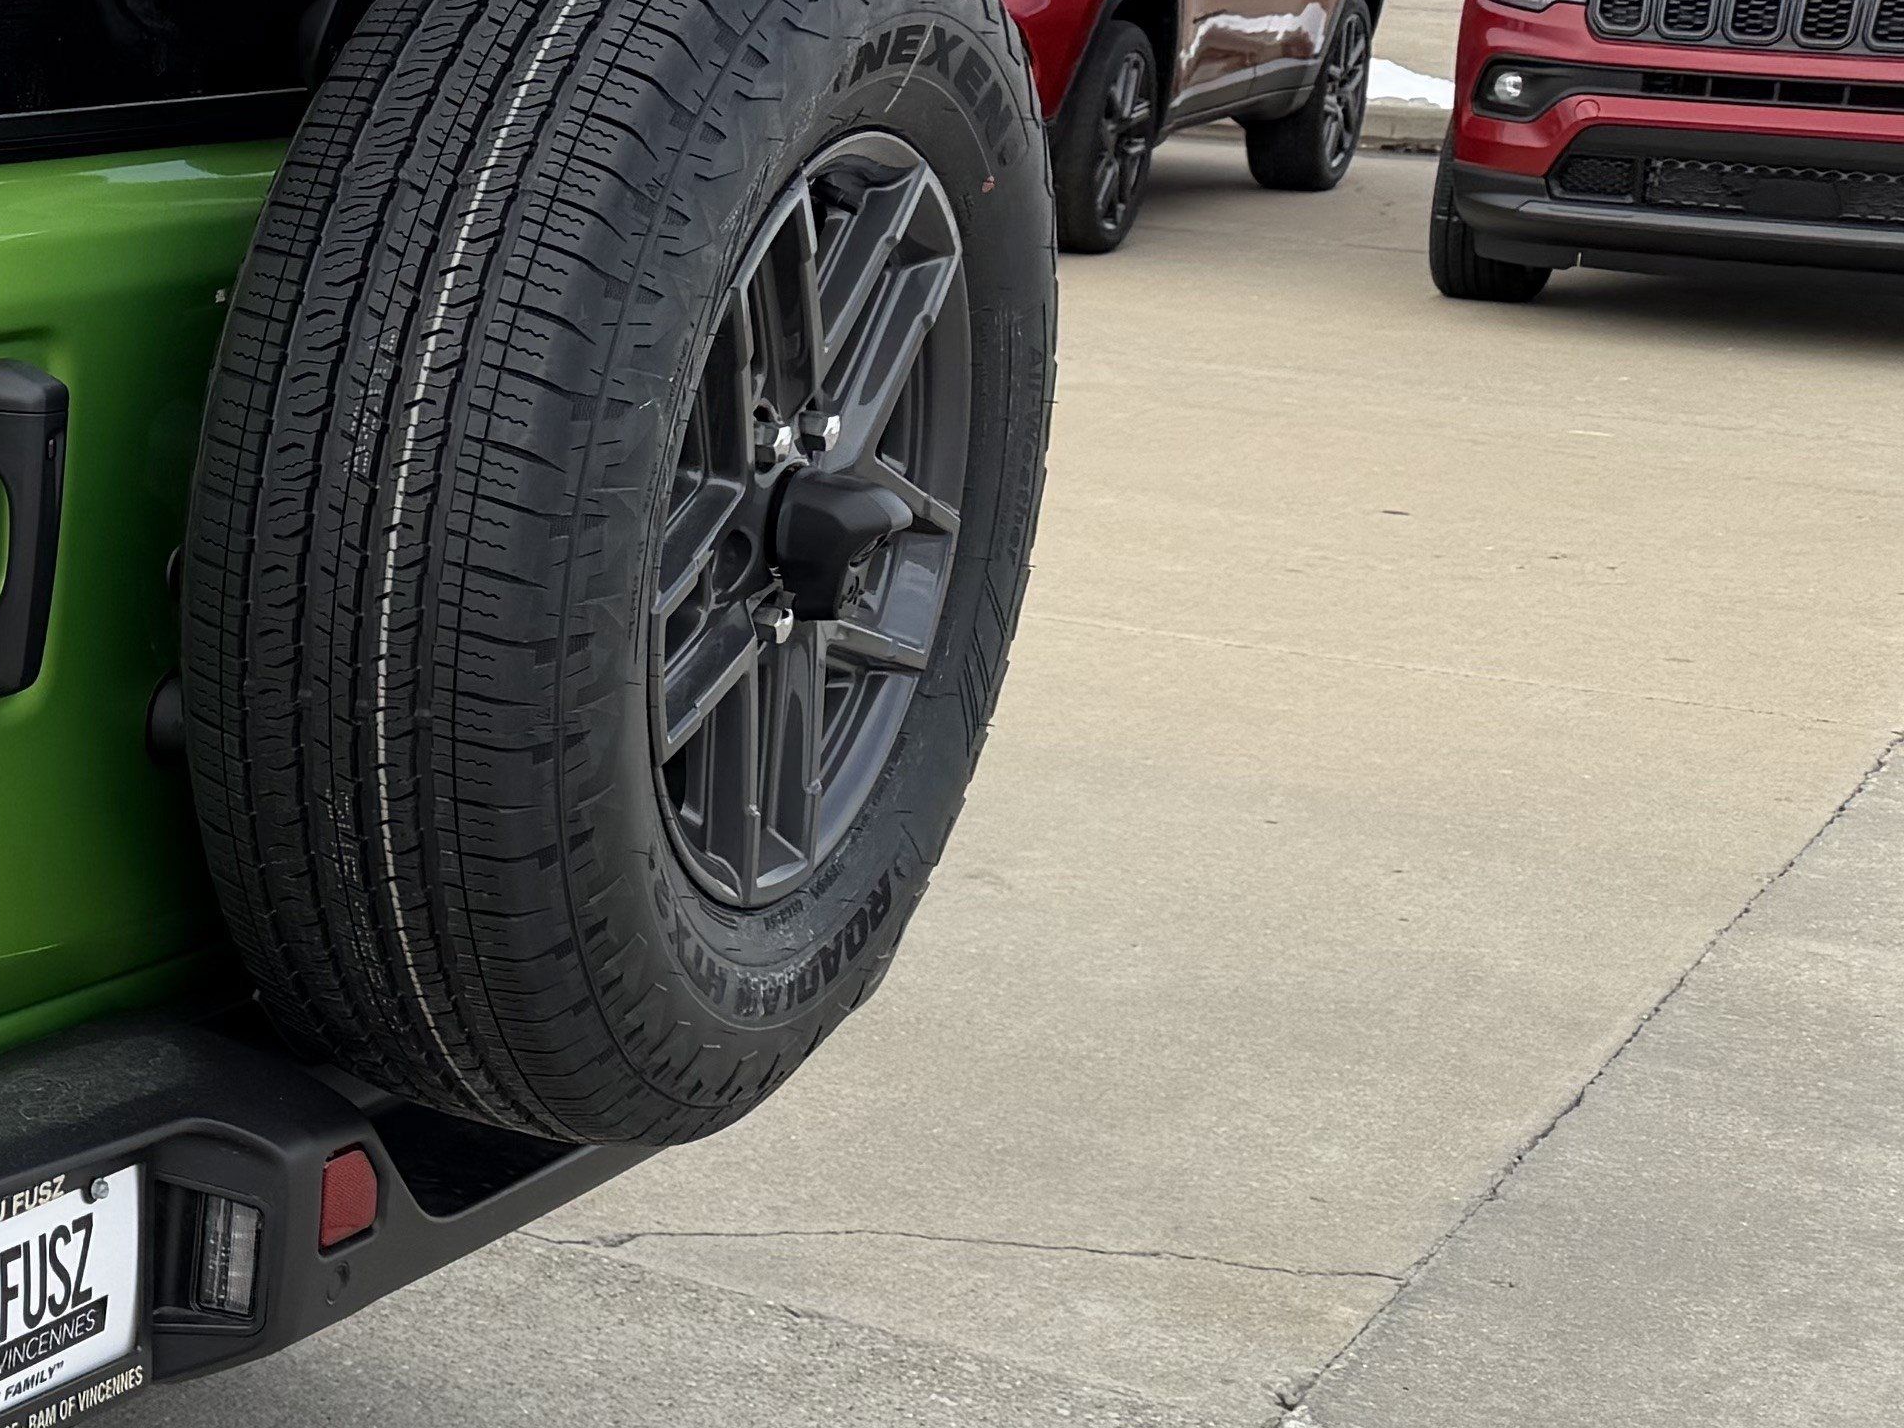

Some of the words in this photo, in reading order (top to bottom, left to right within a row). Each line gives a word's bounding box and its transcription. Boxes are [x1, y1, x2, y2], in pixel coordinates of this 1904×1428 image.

[848, 23, 1014, 151] NEXEN
[11, 1174, 66, 1217] FUSZ
[59, 1400, 75, 1422] OF
[77, 1364, 144, 1413] VINCENNES
